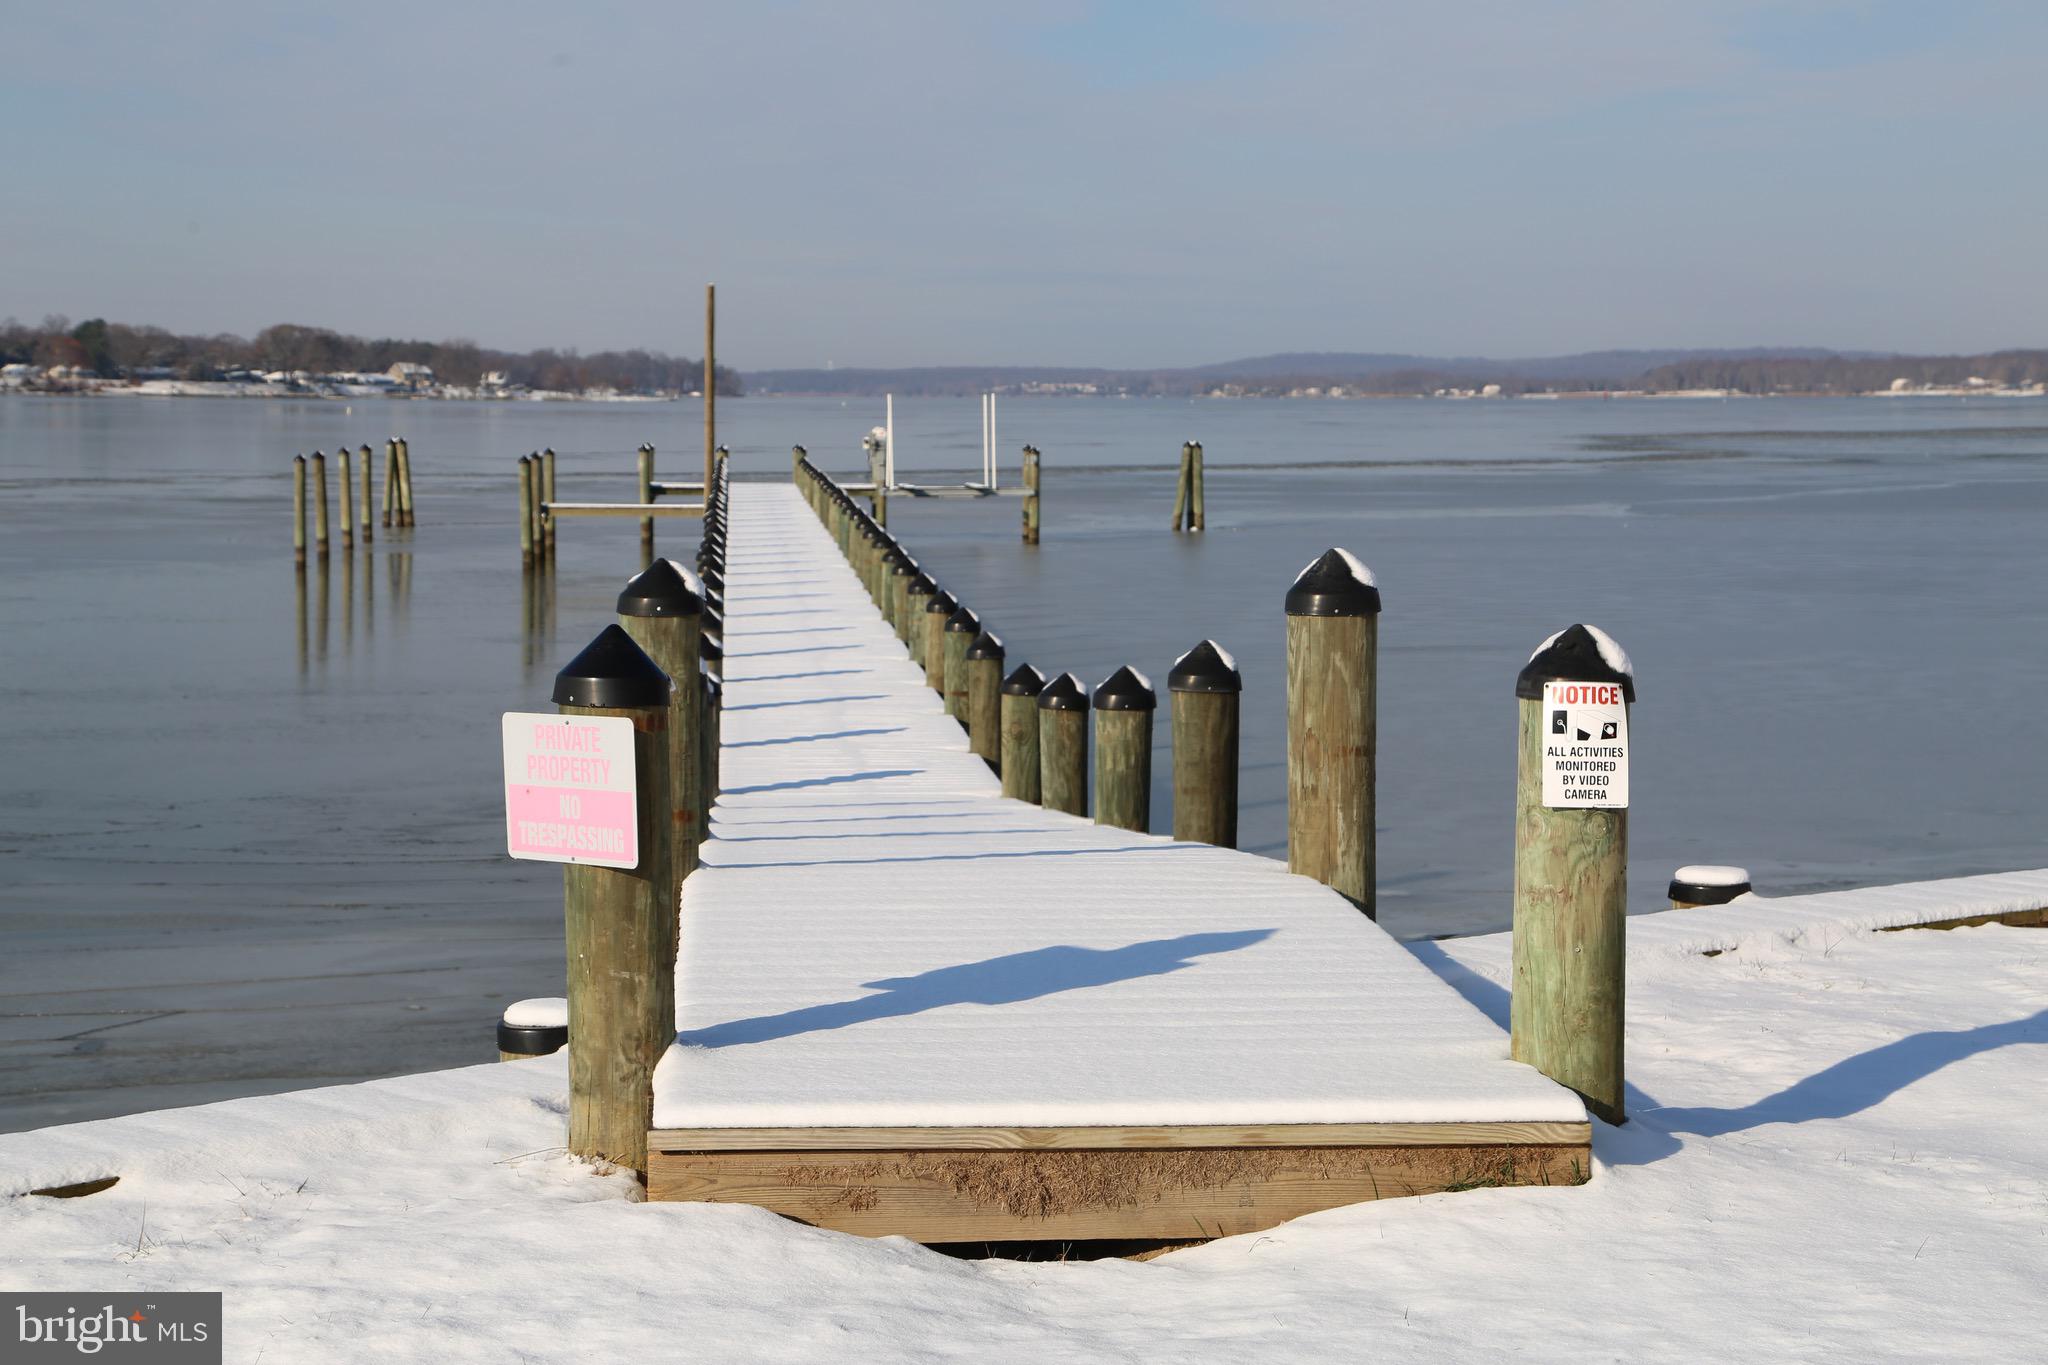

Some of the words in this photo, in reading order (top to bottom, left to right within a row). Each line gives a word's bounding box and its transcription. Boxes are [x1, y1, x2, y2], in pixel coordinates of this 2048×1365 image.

[1552, 686, 1619, 705] NOTICE
[534, 724, 604, 753] PRIVATE
[1547, 746, 1566, 757] ALL
[1569, 747, 1624, 758] ACTIVITIES
[527, 754, 611, 785] PROPERTY
[1555, 761, 1616, 772] MONITORED
[1562, 775, 1576, 785] BY
[1579, 775, 1610, 786] VIDEO
[1564, 789, 1608, 800] CAMERA
[559, 794, 582, 820] NO
[518, 820, 625, 854] TRESPASSING
